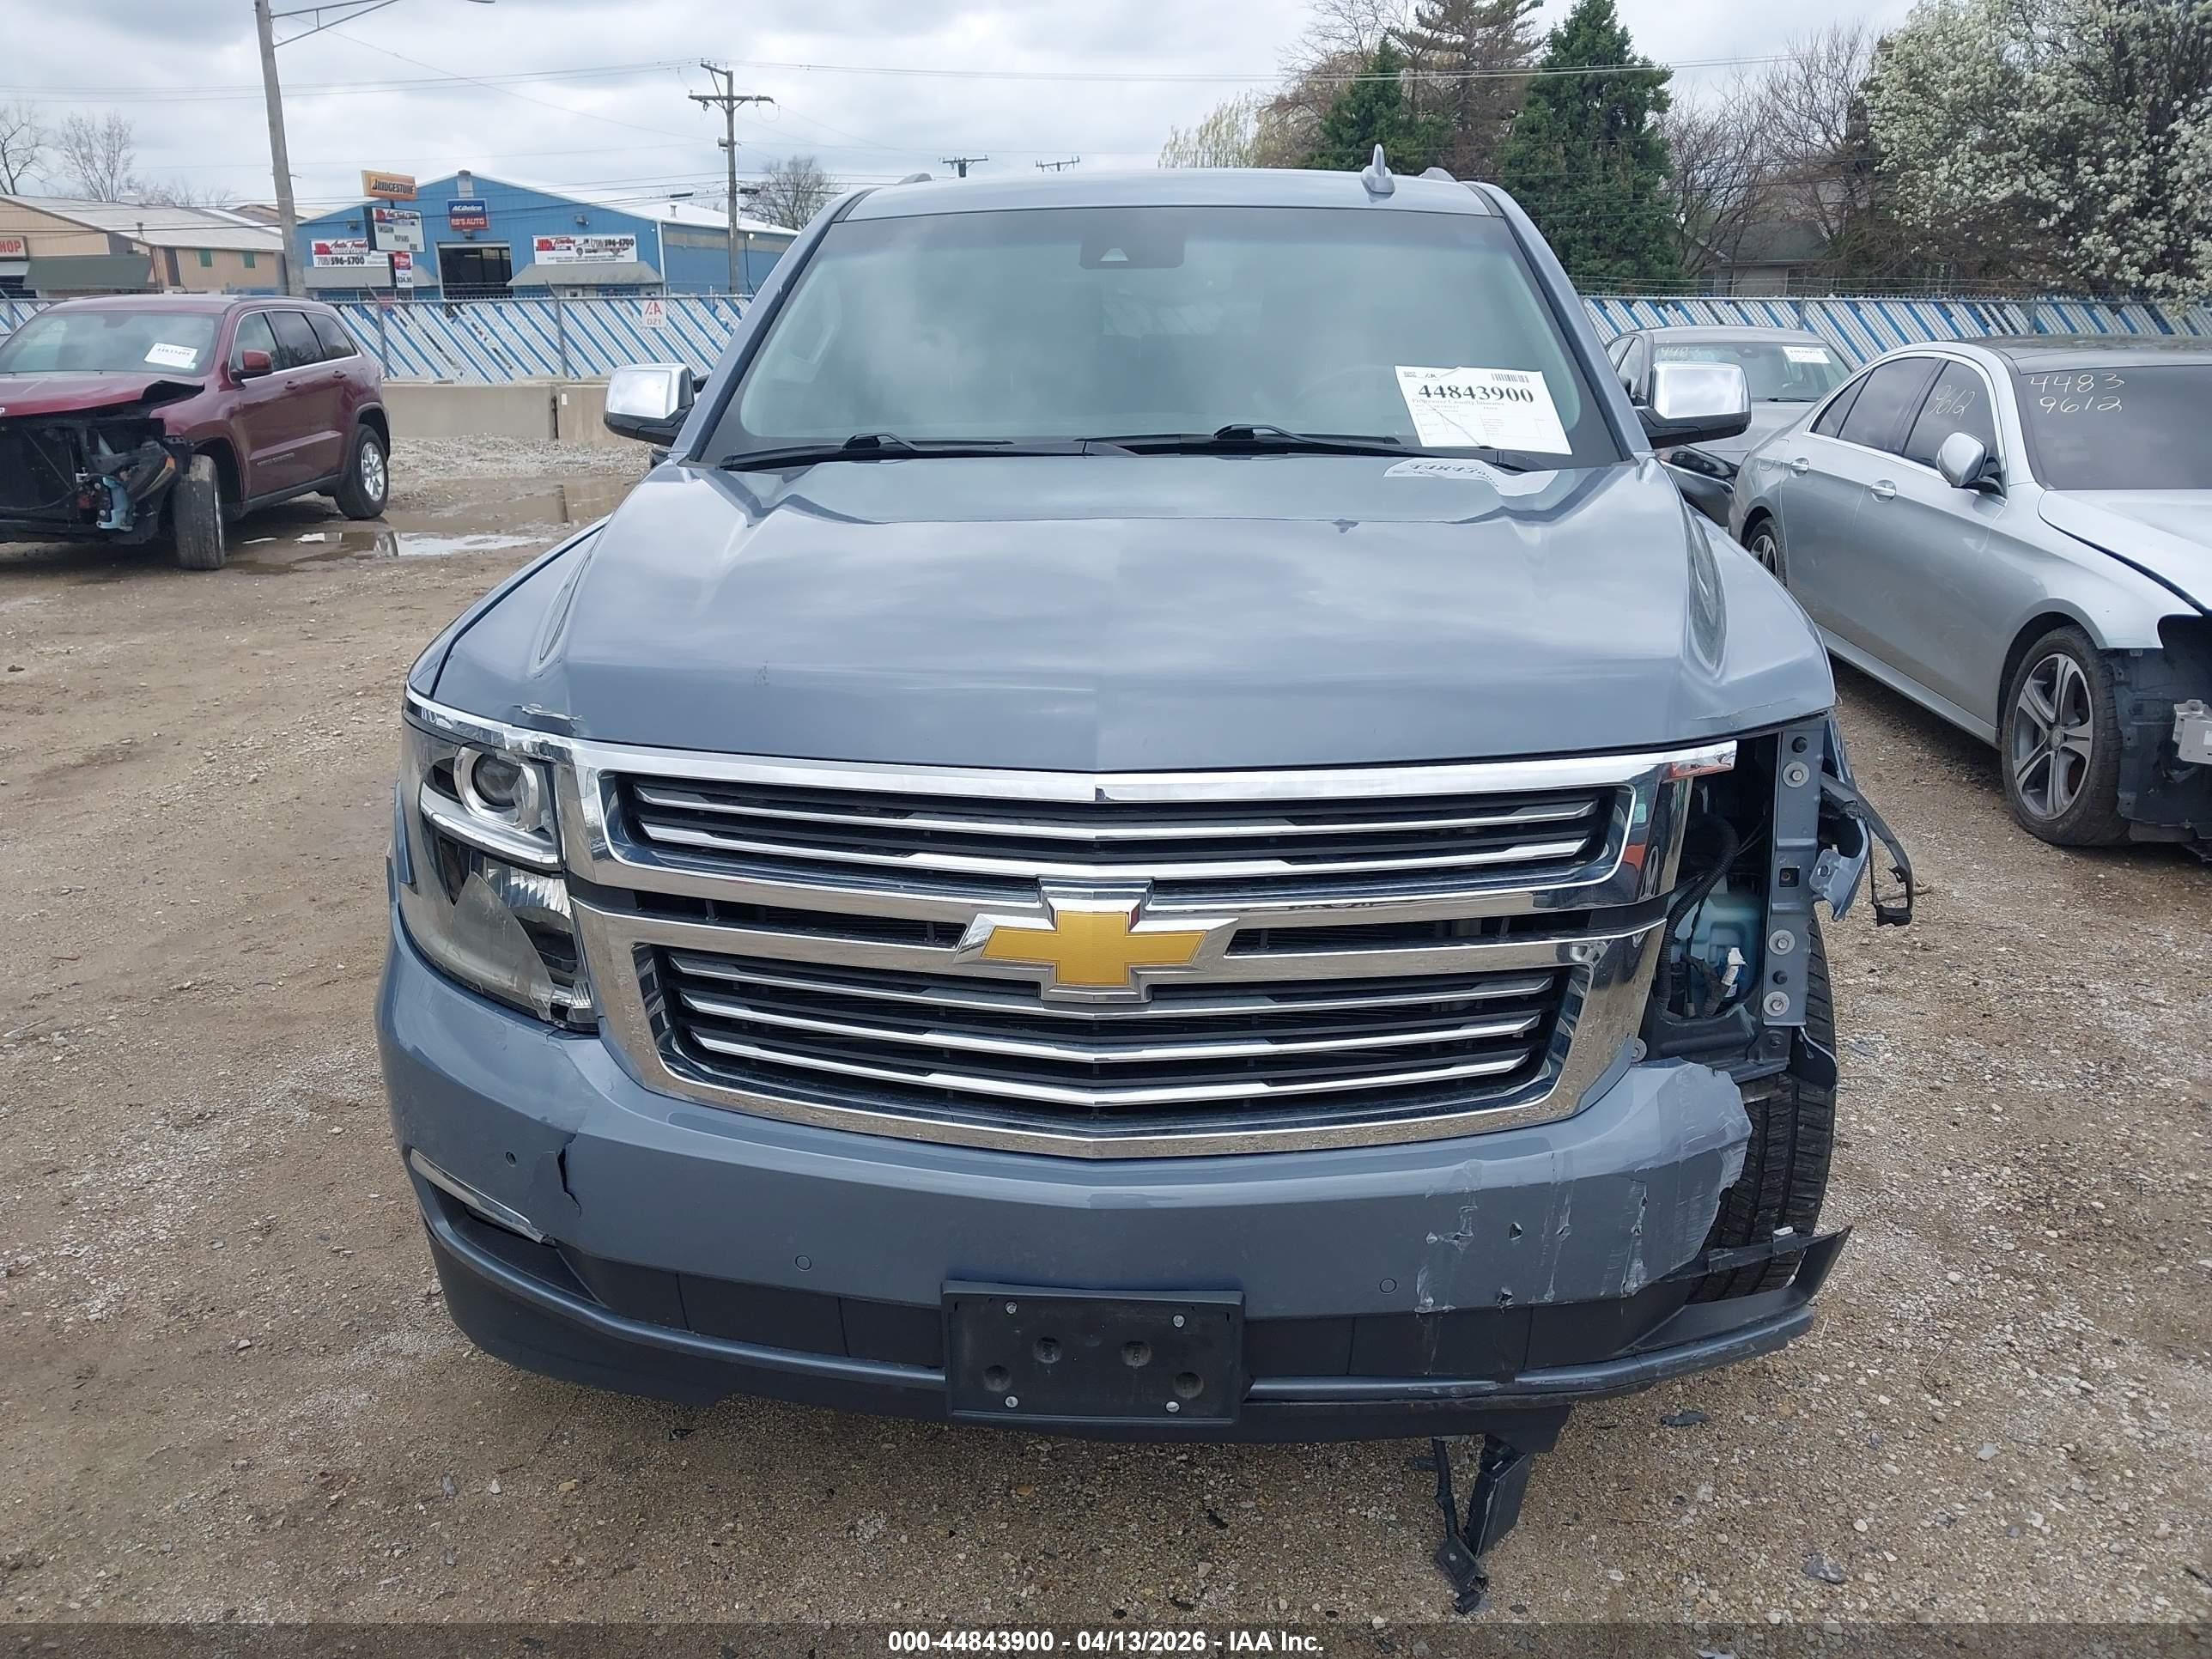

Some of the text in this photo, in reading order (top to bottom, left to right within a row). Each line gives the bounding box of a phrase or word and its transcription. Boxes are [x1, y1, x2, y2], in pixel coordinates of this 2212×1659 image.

[466, 217, 485, 226] AUTO
[331, 257, 365, 265] 596-5700
[2030, 374, 2125, 393] 4483
[1418, 384, 1534, 404] 44843900
[2040, 396, 2123, 414] 9612
